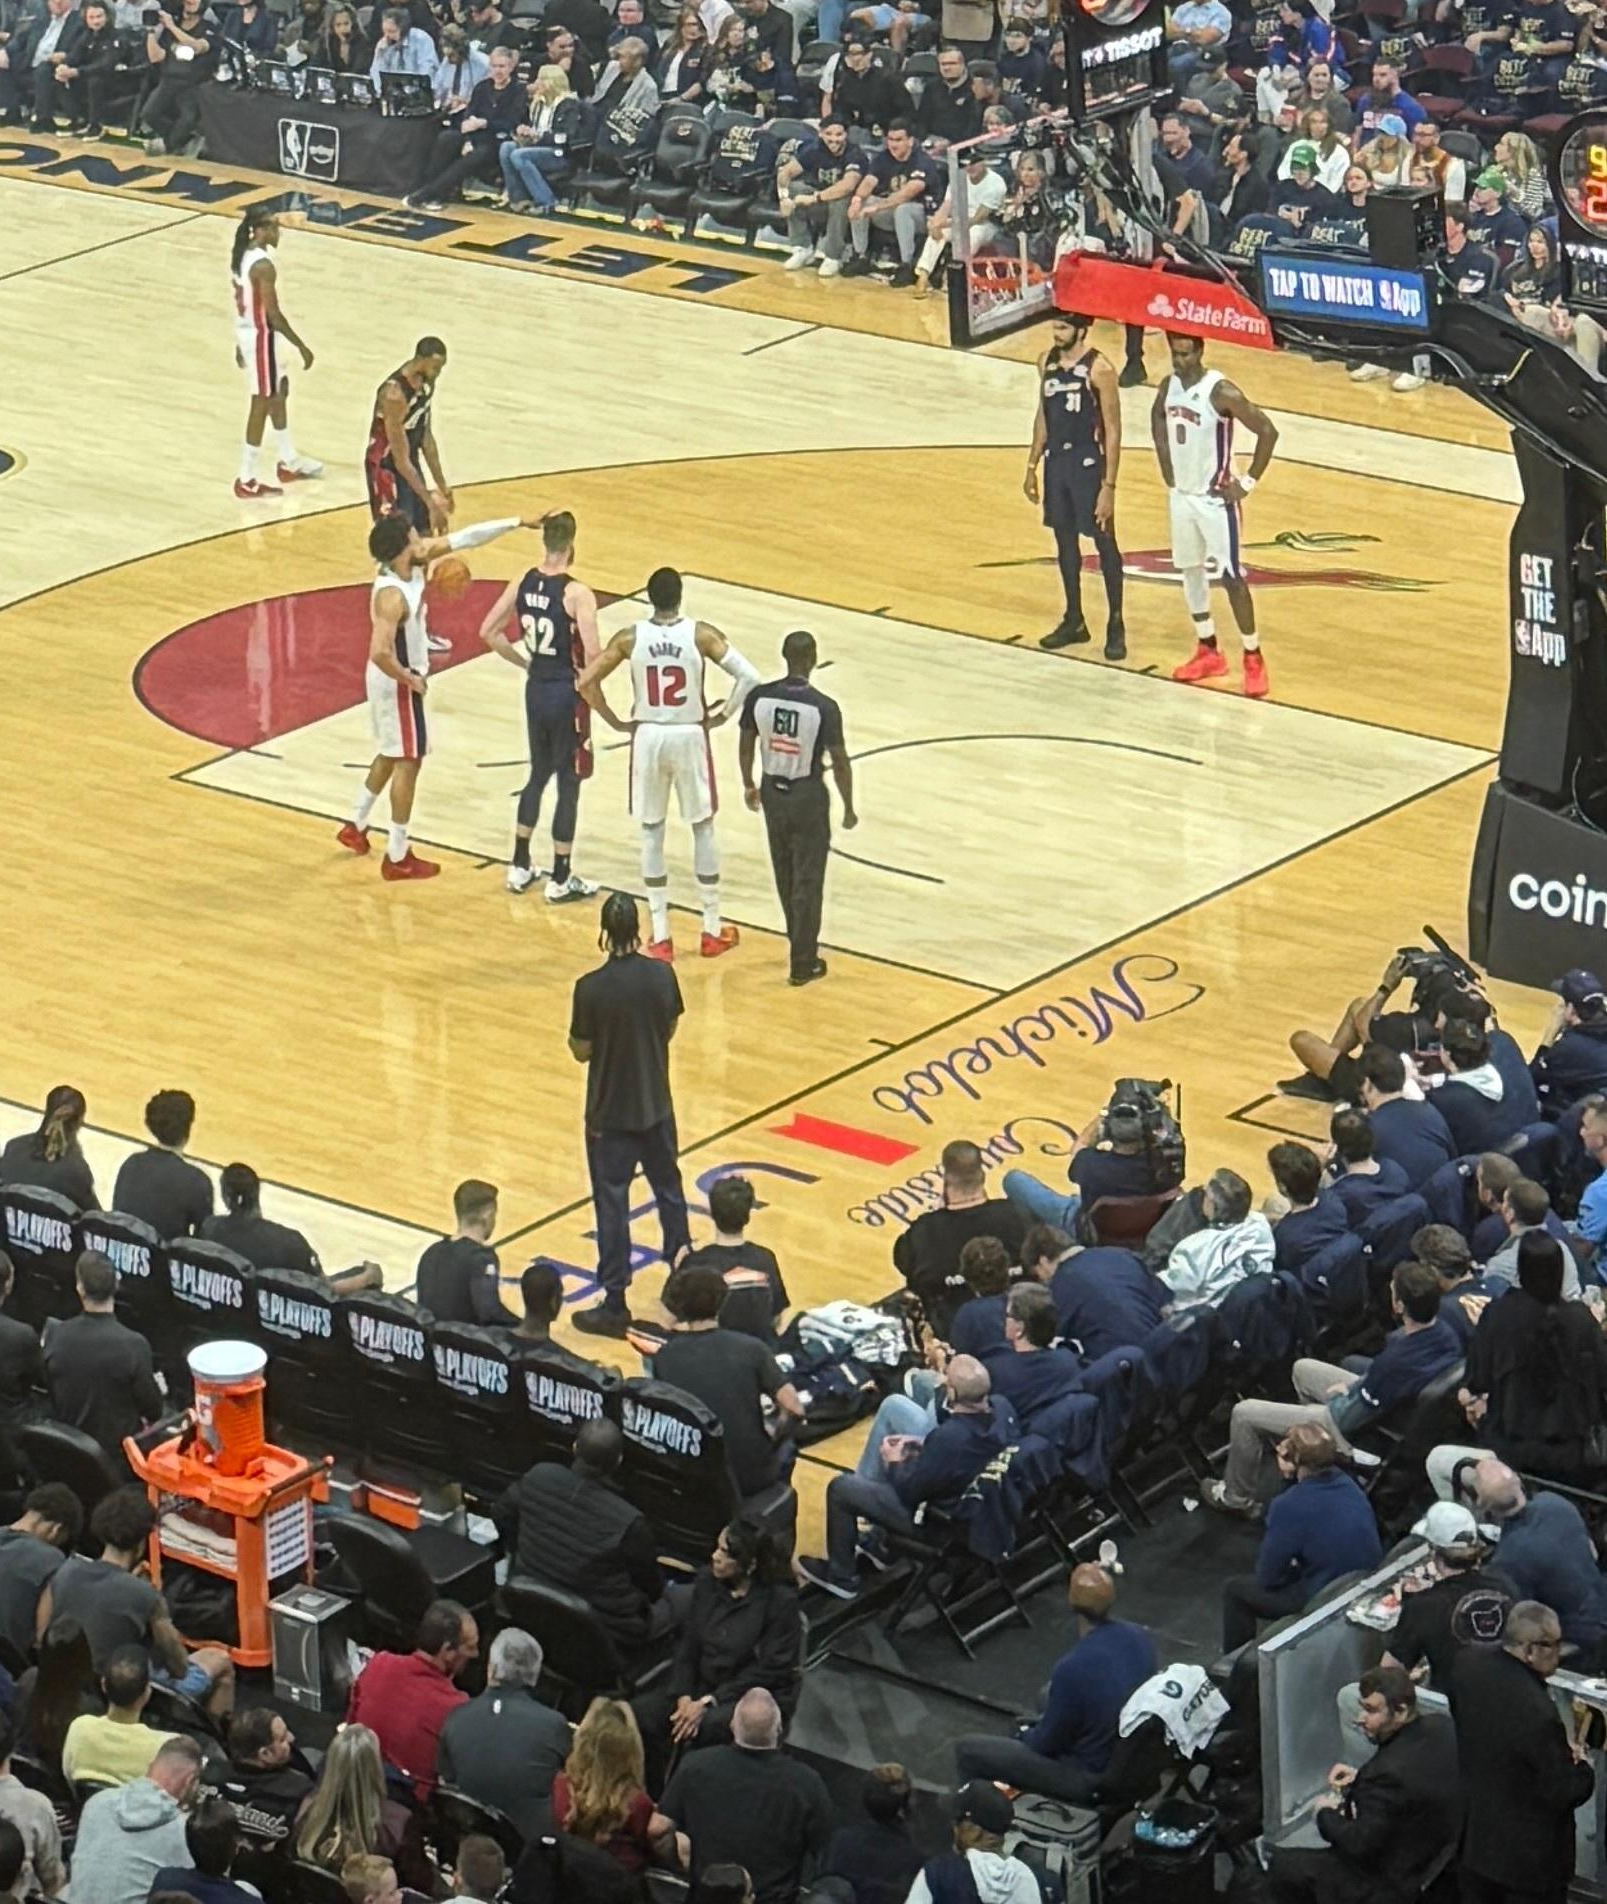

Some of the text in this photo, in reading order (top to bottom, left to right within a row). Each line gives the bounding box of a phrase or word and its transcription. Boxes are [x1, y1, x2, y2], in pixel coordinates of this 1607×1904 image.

[1104, 25, 1163, 64] TISSOT
[1269, 267, 1422, 318] TAP TO WATCH App
[1520, 553, 1553, 590] GET
[1521, 587, 1557, 624] THE
[1531, 621, 1567, 667] App
[646, 664, 688, 708] 12
[872, 953, 1206, 1126] Michelob
[182, 1263, 243, 1309] PLAYOFFS
[270, 1291, 332, 1339] PLAYOFFS
[359, 1314, 425, 1361] PLAYOFFS
[446, 1346, 509, 1395] PLAYOFFS
[636, 1403, 703, 1458] PLAYOFFS
